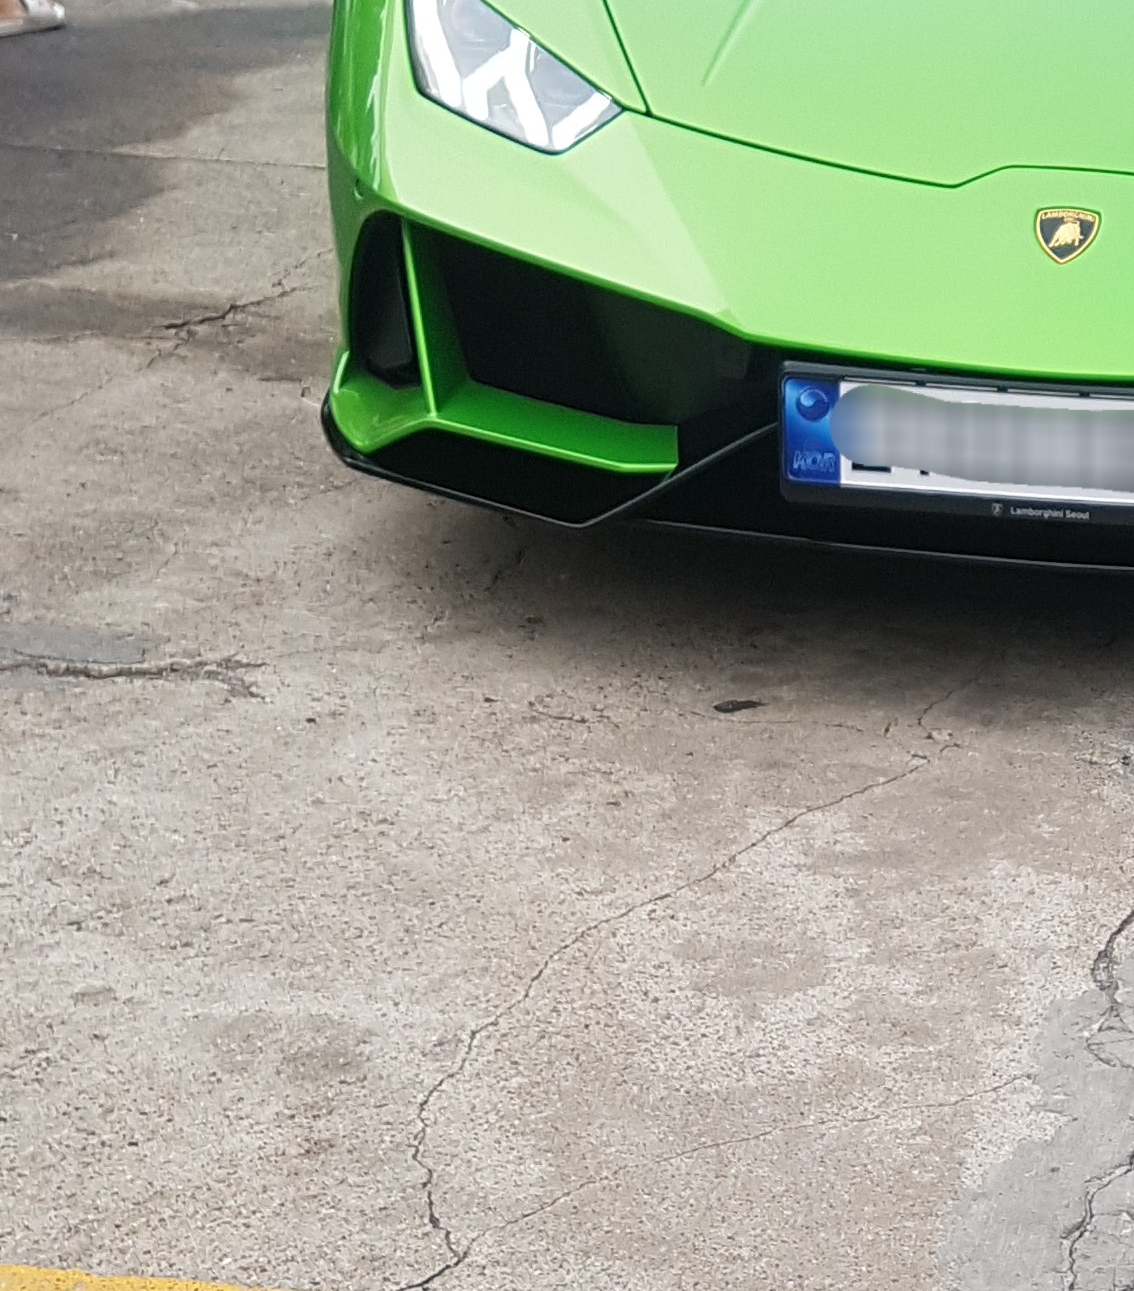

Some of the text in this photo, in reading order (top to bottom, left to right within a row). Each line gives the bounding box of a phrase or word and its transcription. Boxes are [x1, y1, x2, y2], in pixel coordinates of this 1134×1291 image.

[793, 450, 835, 473] KOR
[1010, 506, 1090, 520] Lamborghini Seoul
